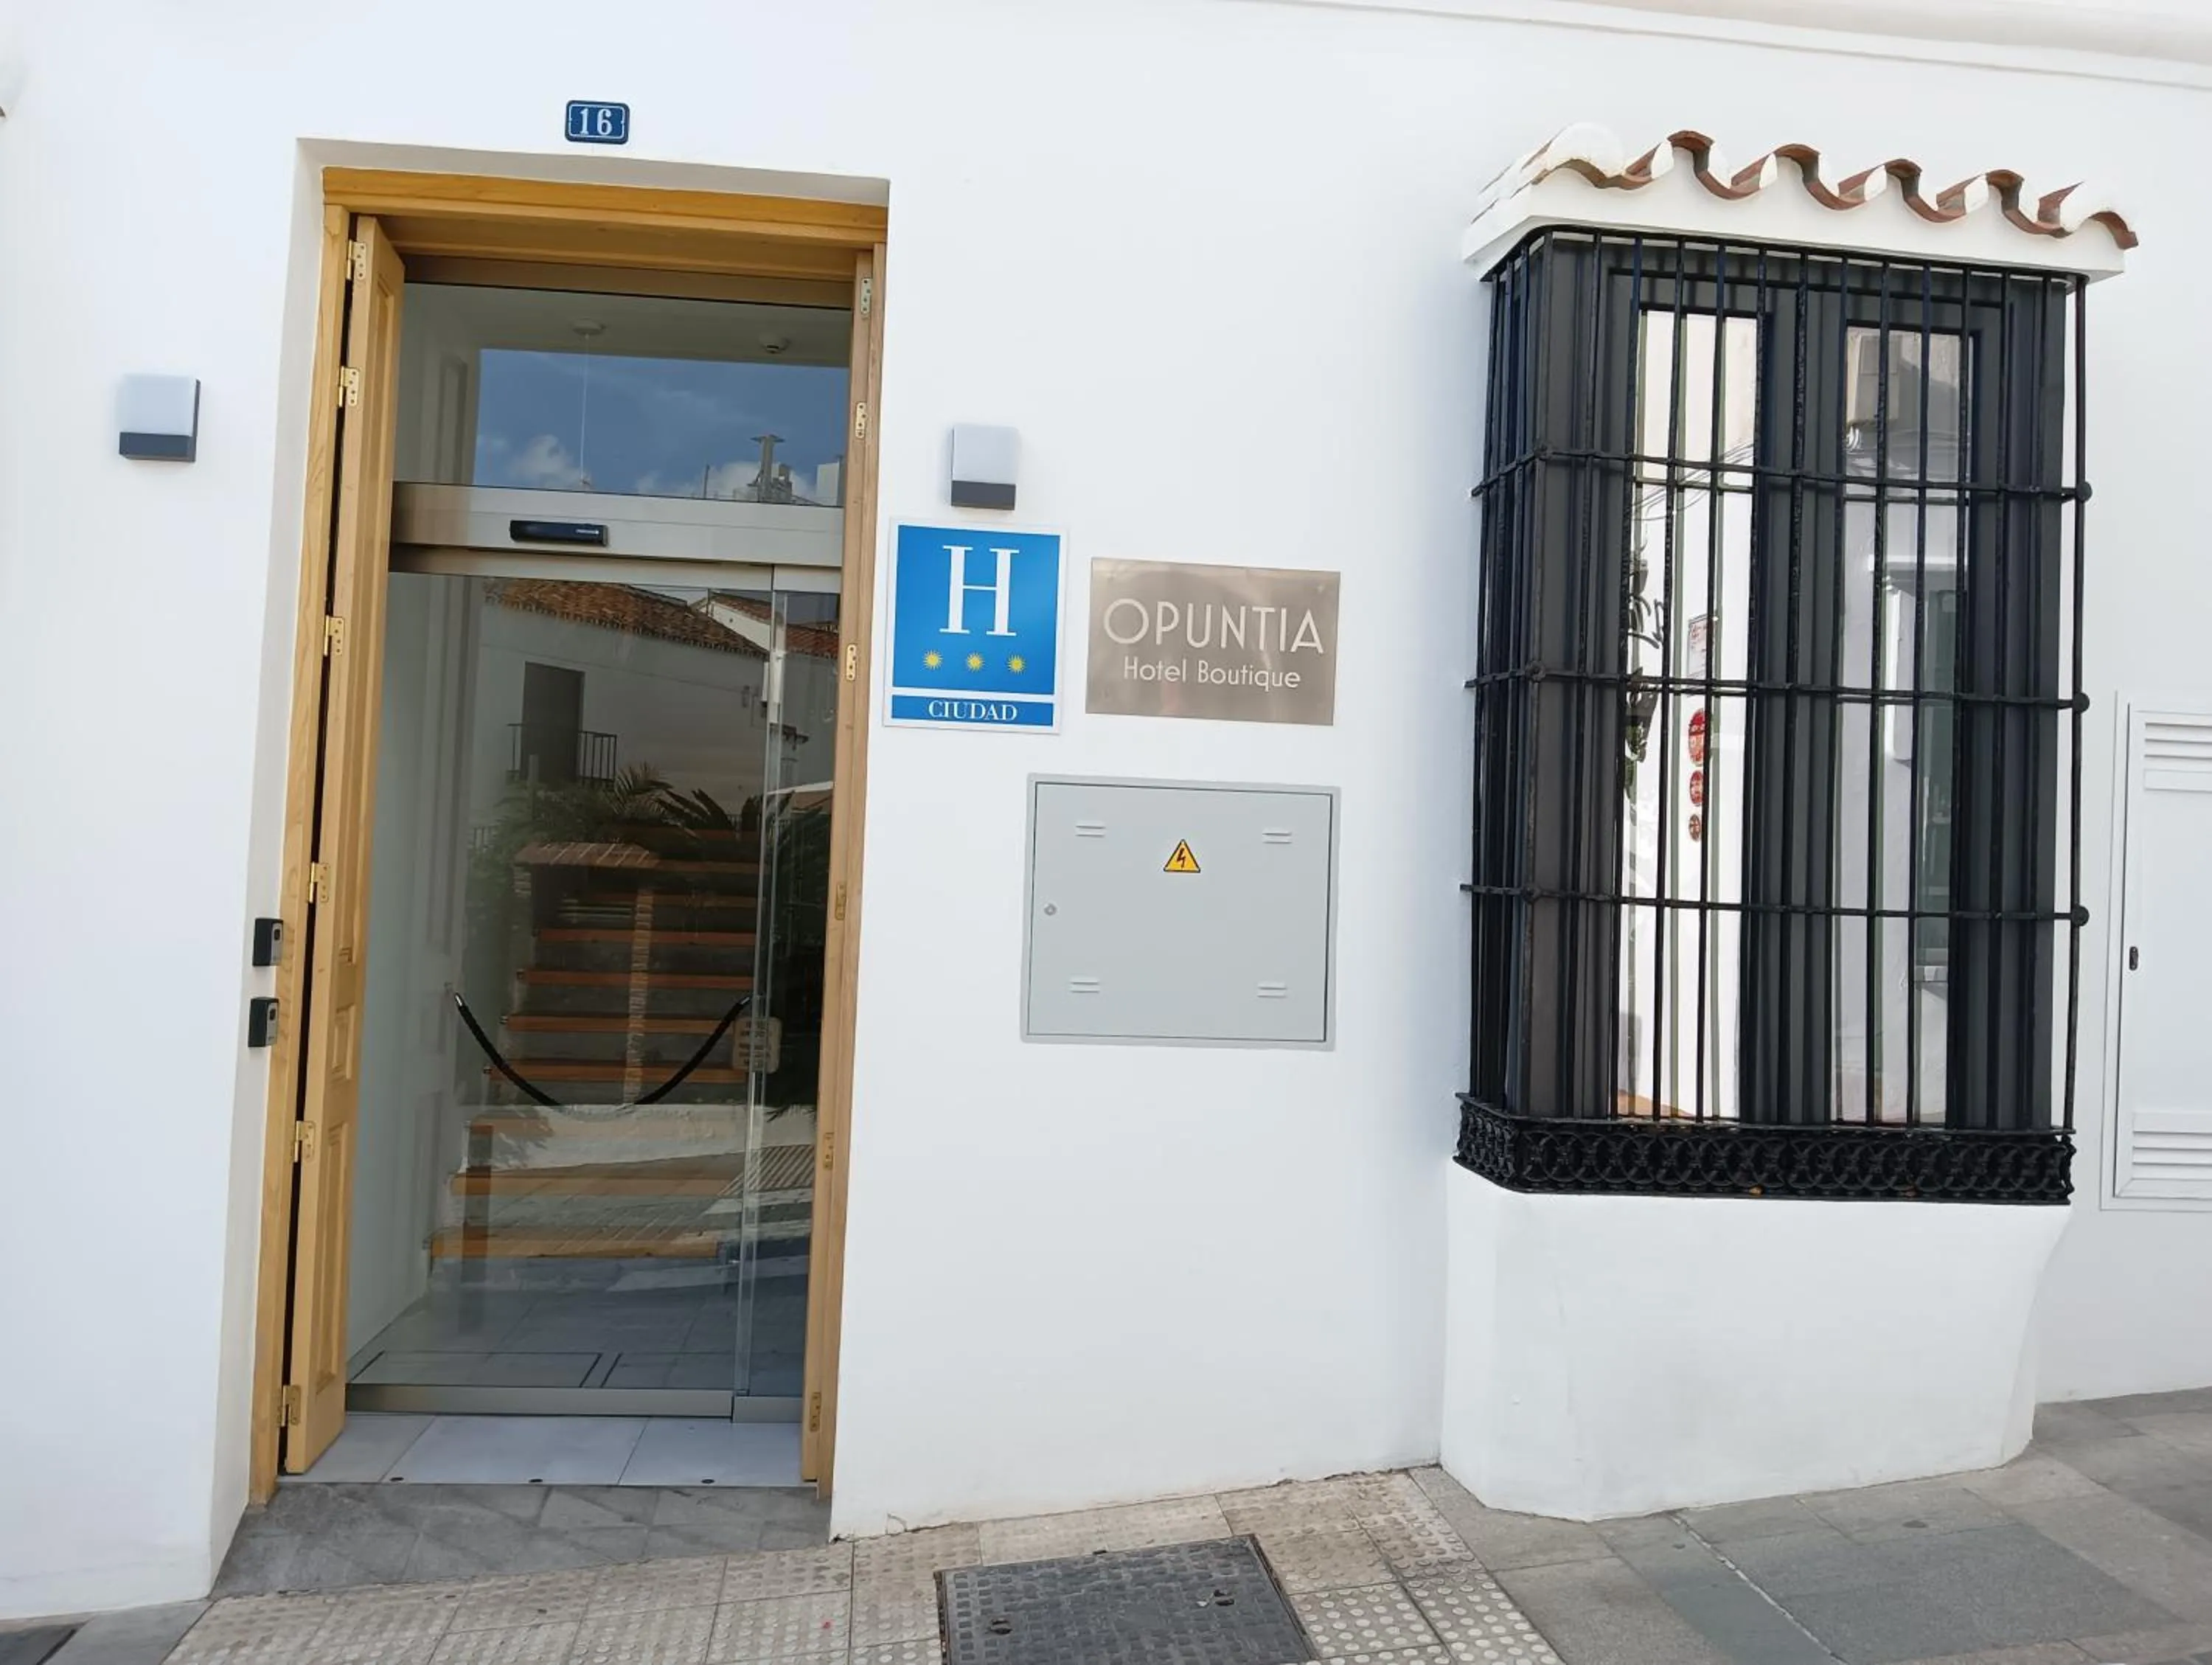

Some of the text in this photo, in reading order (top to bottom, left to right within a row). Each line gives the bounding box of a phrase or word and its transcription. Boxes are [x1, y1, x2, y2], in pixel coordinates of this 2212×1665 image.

[580, 108, 613, 136] 16
[939, 545, 1020, 636] H
[1104, 598, 1324, 654] OPUNTIA
[1124, 656, 1301, 692] Hotel Boutique
[928, 700, 1018, 721] CIUDAD
